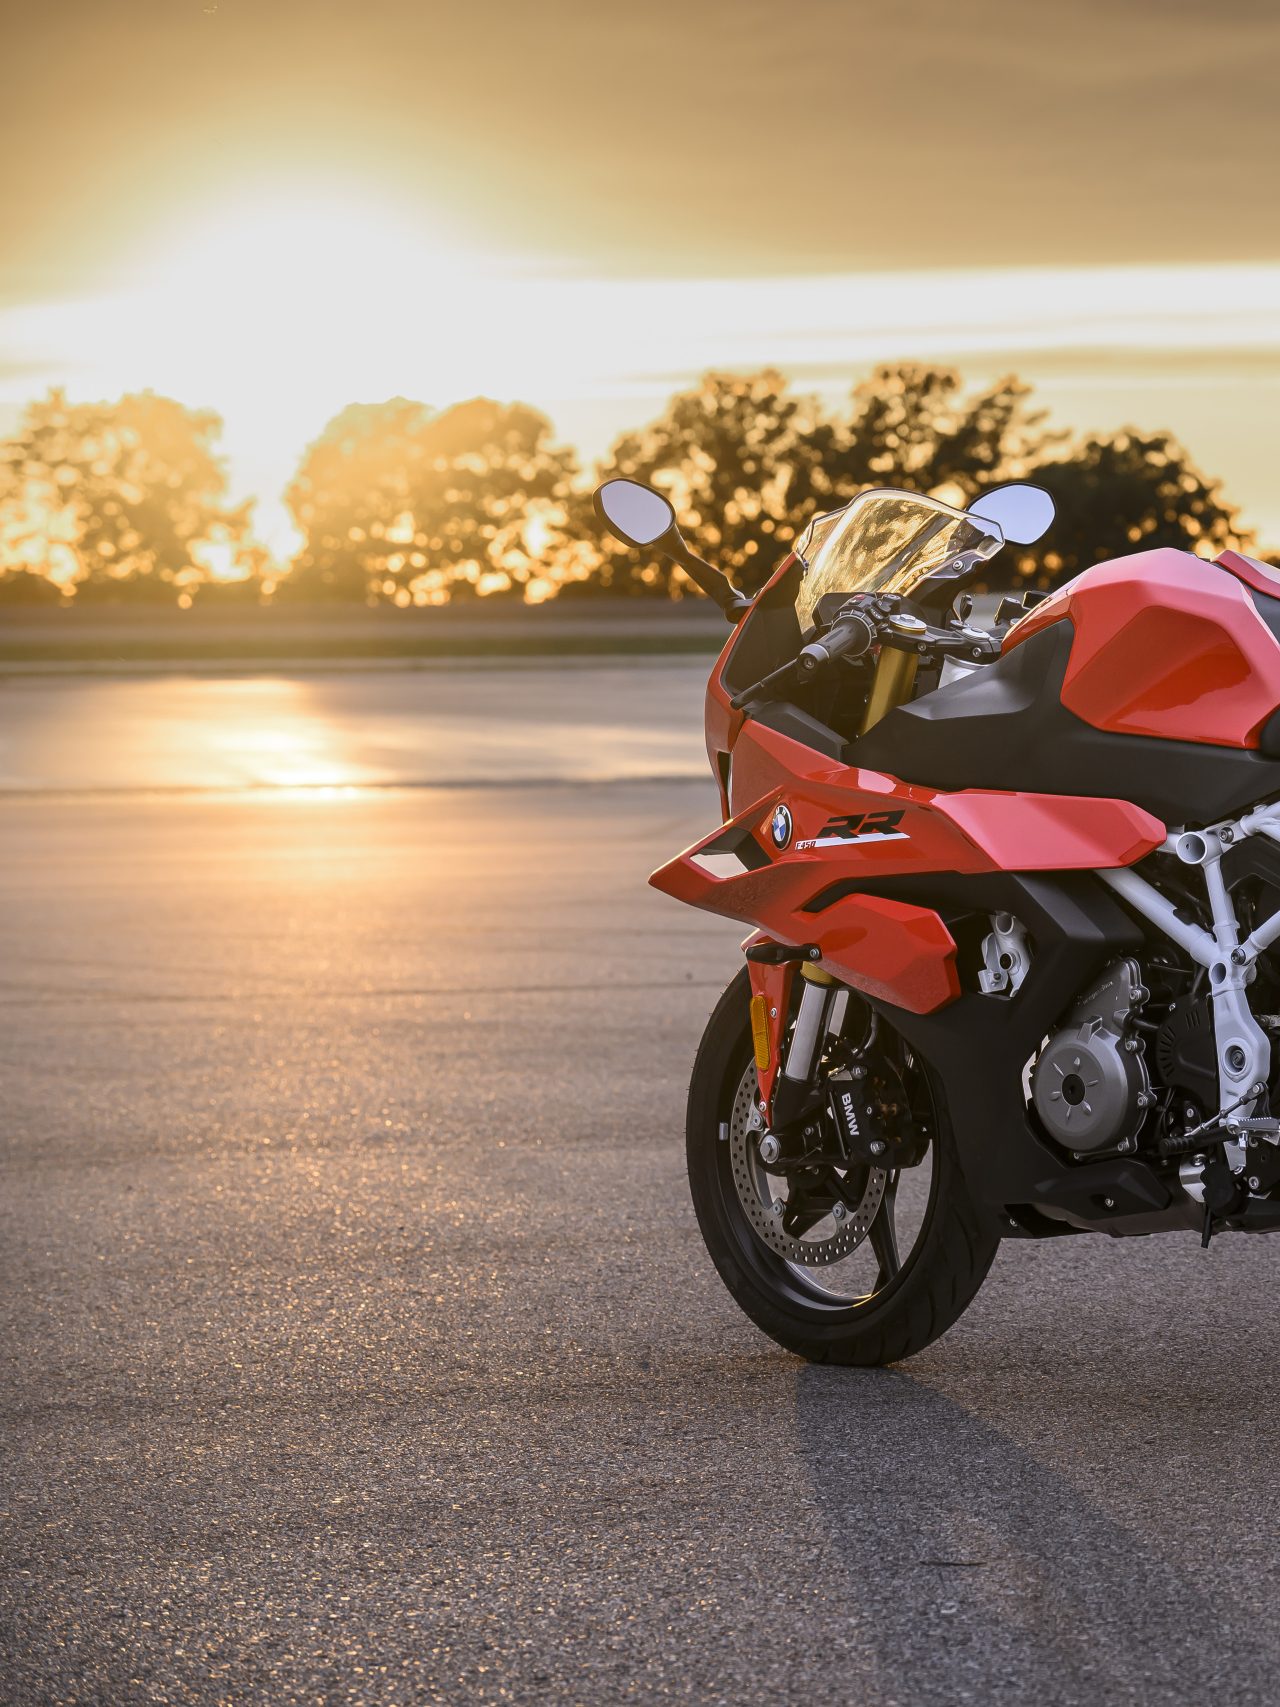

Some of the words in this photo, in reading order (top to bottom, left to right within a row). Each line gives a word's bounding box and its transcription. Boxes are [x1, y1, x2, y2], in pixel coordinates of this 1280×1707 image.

[816, 810, 905, 839] RR
[796, 841, 816, 849] F450
[842, 1092, 860, 1136] BMW
